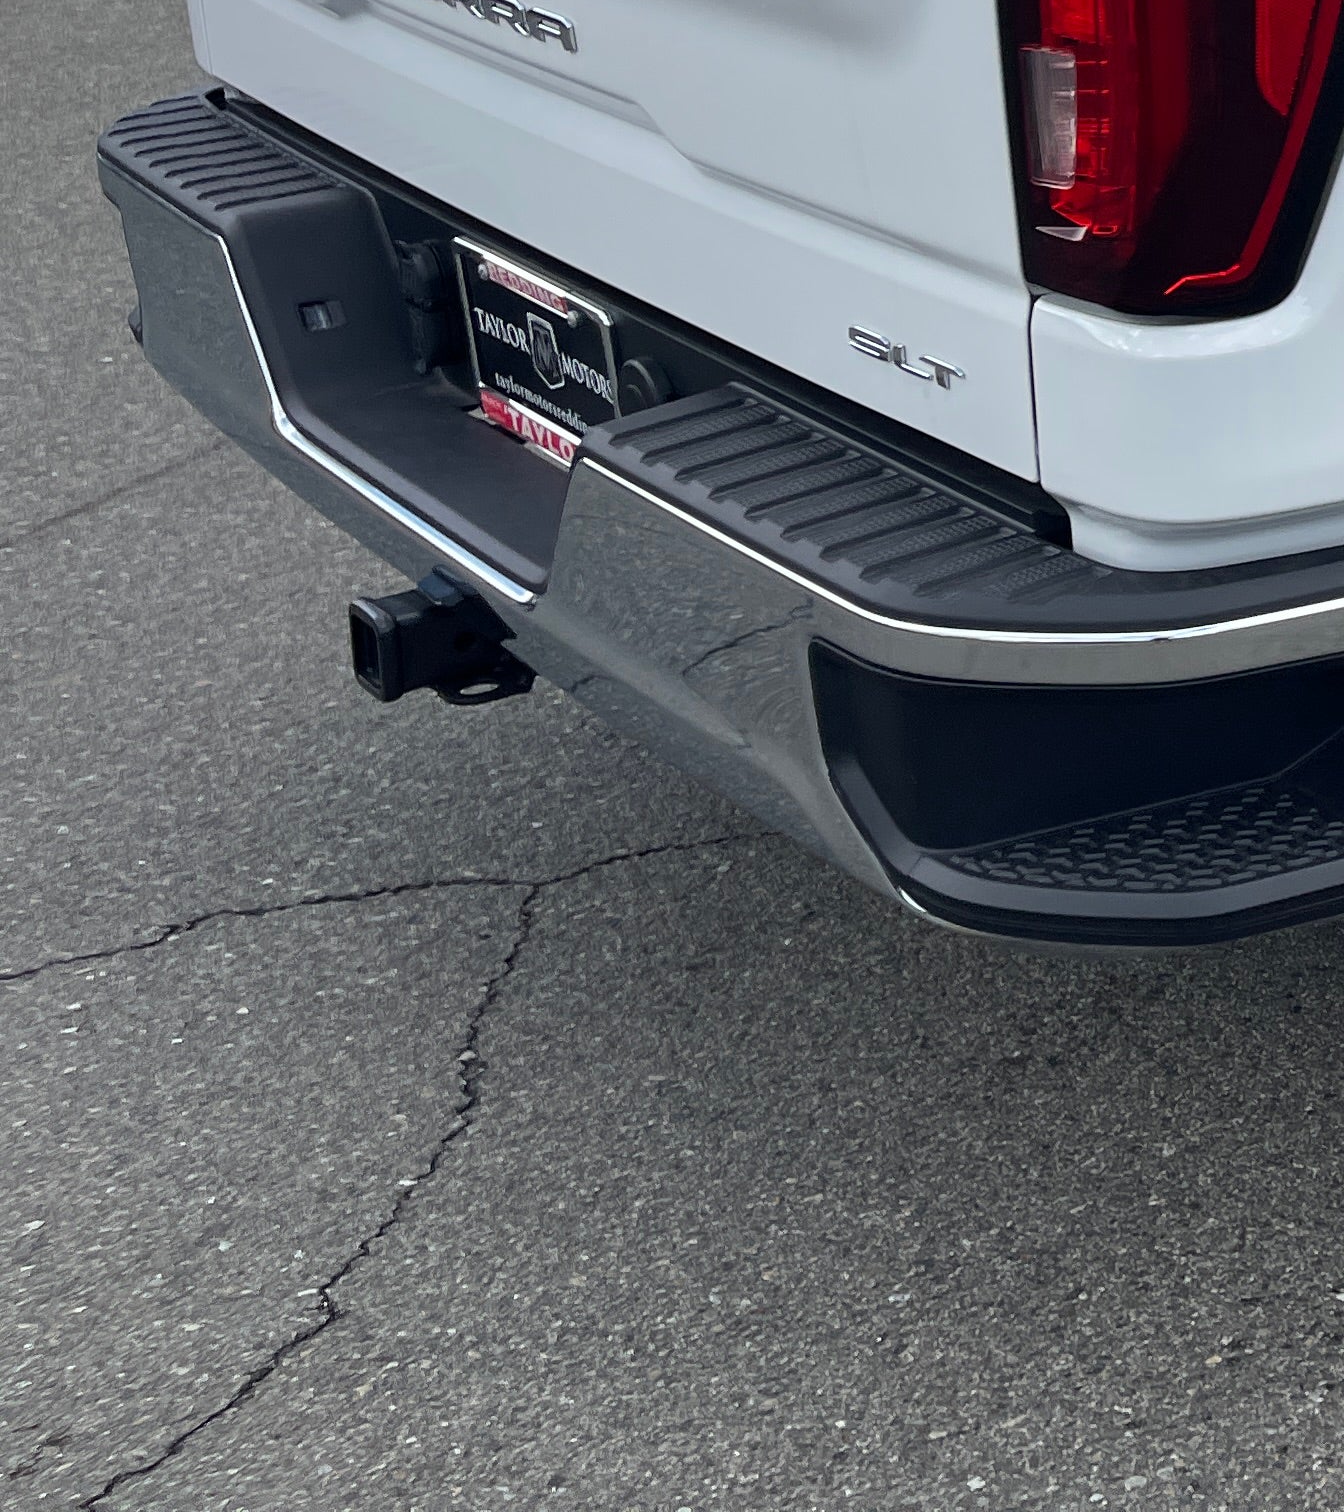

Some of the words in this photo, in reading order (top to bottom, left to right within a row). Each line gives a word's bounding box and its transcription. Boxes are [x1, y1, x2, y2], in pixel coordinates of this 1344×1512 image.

[474, 306, 531, 356] TAYLOR
[847, 323, 967, 391] SLT
[495, 372, 589, 434] taylormotorsreddin
